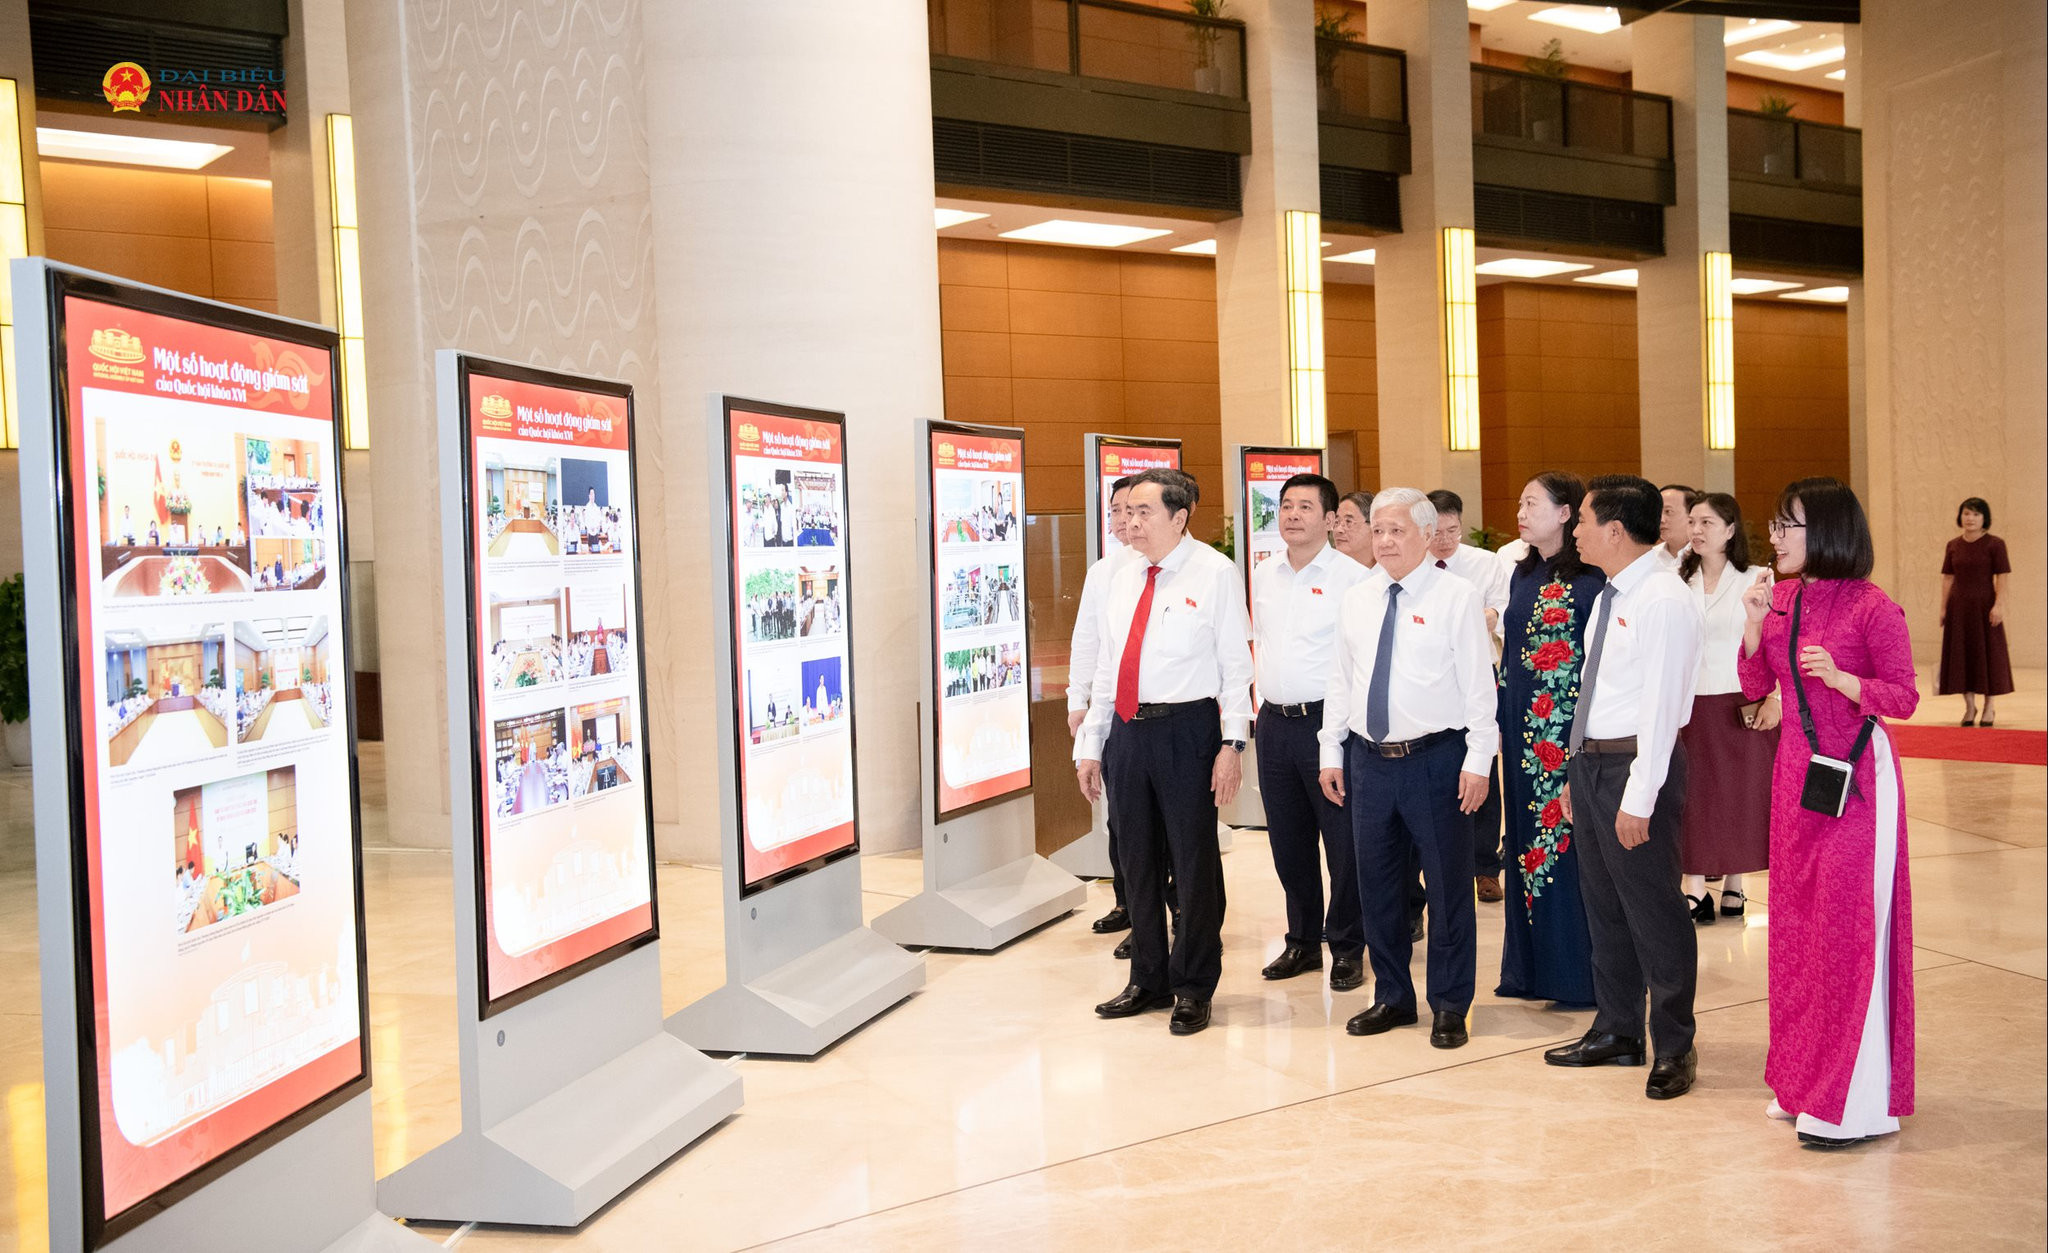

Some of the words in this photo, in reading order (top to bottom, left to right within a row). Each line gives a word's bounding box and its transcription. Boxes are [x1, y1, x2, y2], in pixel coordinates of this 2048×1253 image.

[153, 346, 181, 376] Một
[182, 352, 198, 375] số
[199, 355, 230, 383] hoạt
[230, 361, 261, 390] động
[262, 367, 290, 393] giám
[291, 373, 309, 394] sát
[155, 375, 173, 392] của
[174, 379, 197, 395] Quốc
[197, 382, 211, 399] hội
[232, 387, 247, 402] XVI
[516, 405, 533, 424] Một
[534, 406, 544, 424] số
[544, 408, 563, 428] hoạt
[563, 411, 582, 431] động
[583, 414, 600, 432] giám
[601, 417, 613, 432] sát
